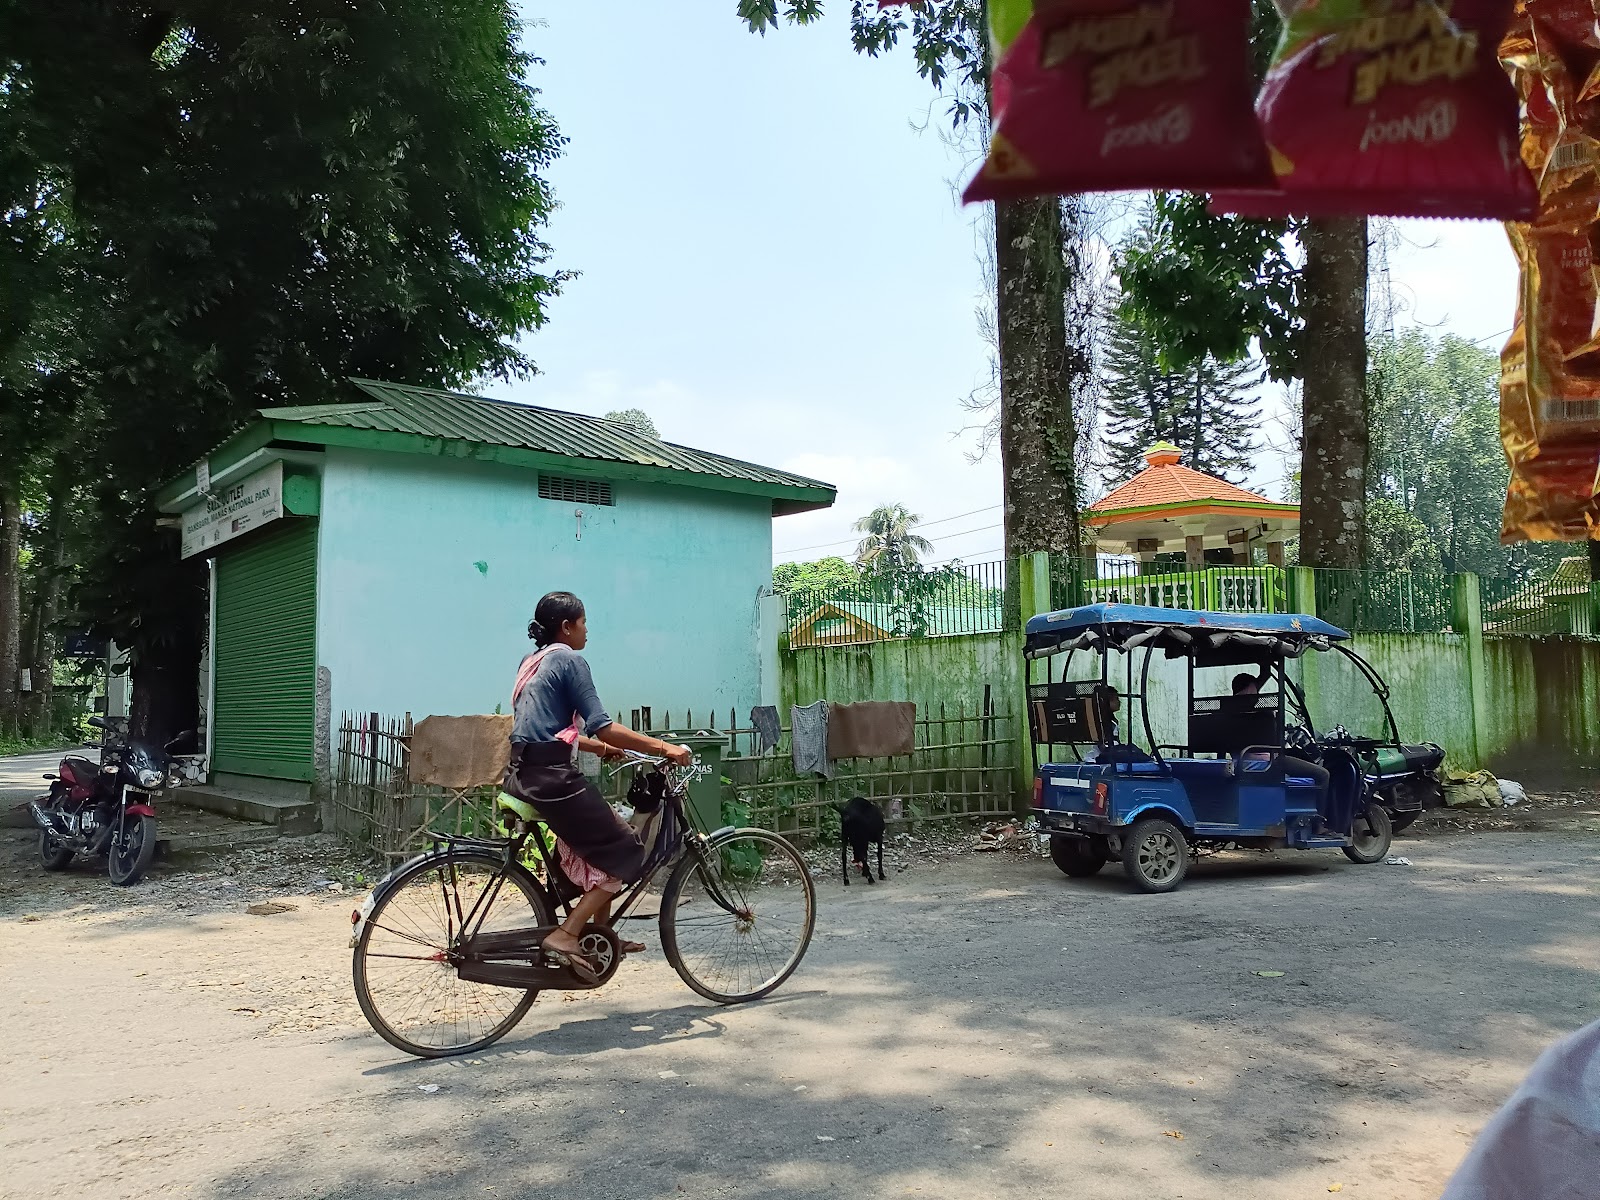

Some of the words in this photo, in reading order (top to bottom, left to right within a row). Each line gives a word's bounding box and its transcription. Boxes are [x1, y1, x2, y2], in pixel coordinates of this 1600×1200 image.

[221, 484, 244, 506] OUTLET
[228, 495, 254, 514] NATIONAL
[255, 487, 271, 502] PARK
